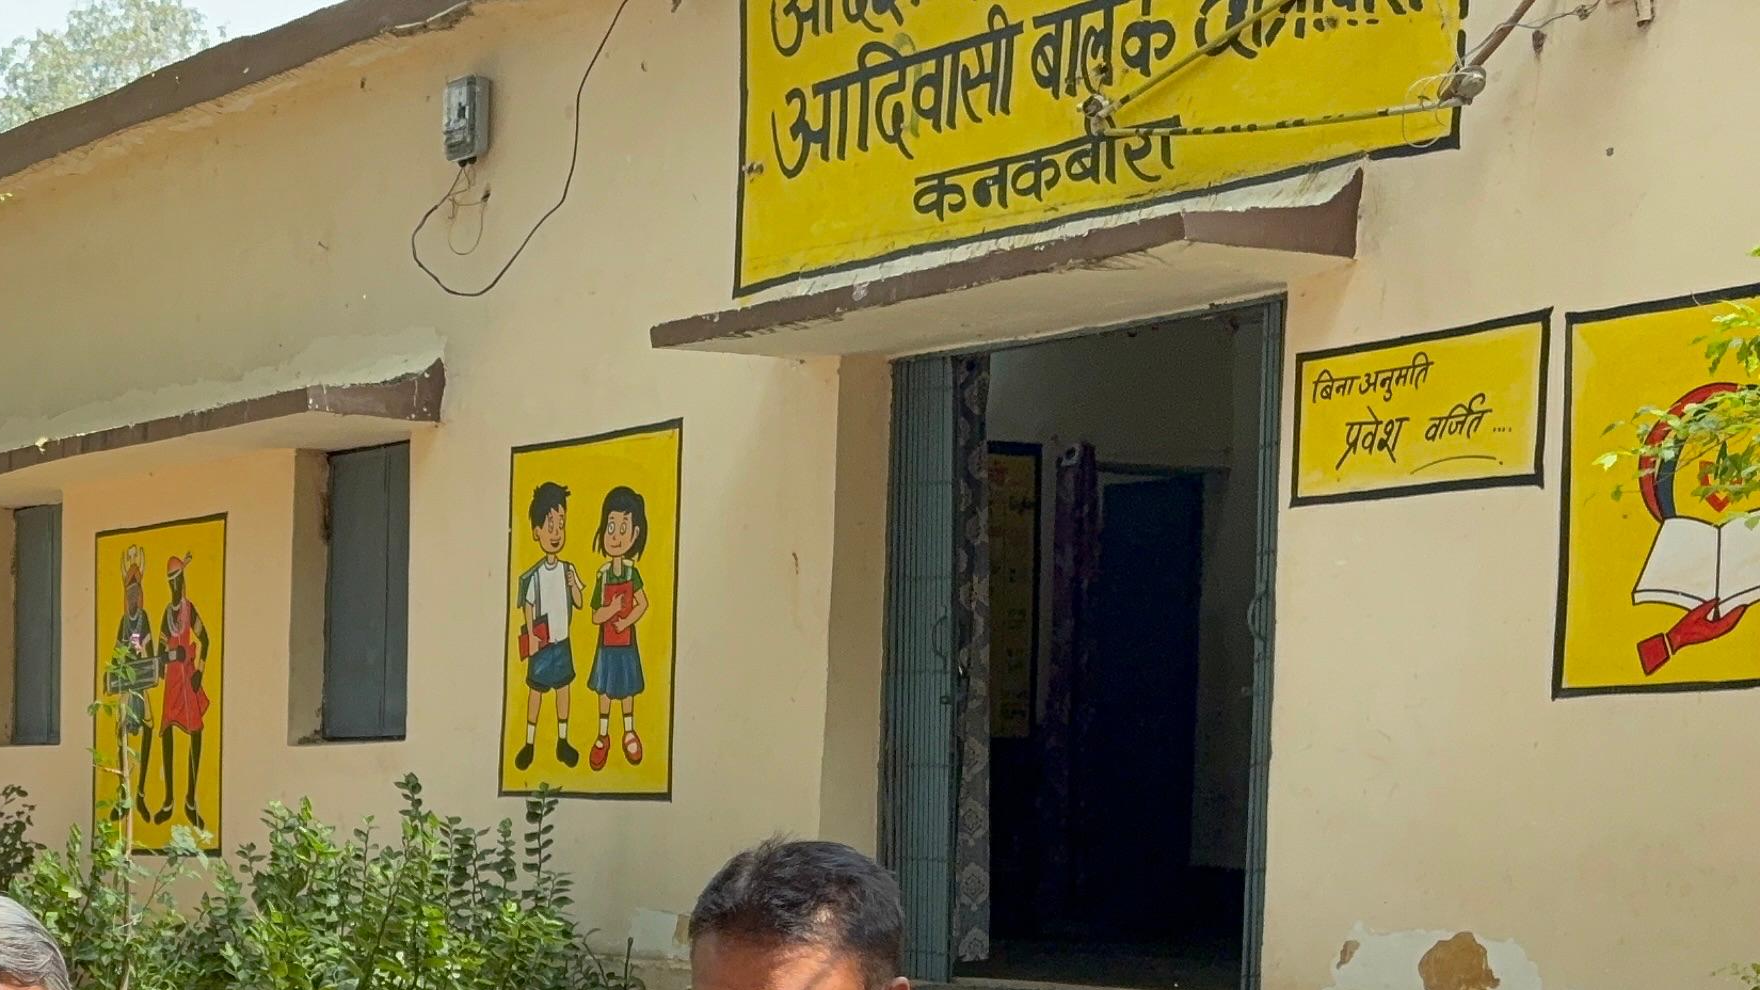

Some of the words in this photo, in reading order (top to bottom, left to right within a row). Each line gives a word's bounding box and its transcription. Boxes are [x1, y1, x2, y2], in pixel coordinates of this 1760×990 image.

[771, 4, 1024, 179] आदिवासी
[1312, 368, 1361, 404] बिना
[1358, 351, 1435, 402] अनुमति
[1335, 405, 1410, 471] प्रवेश
